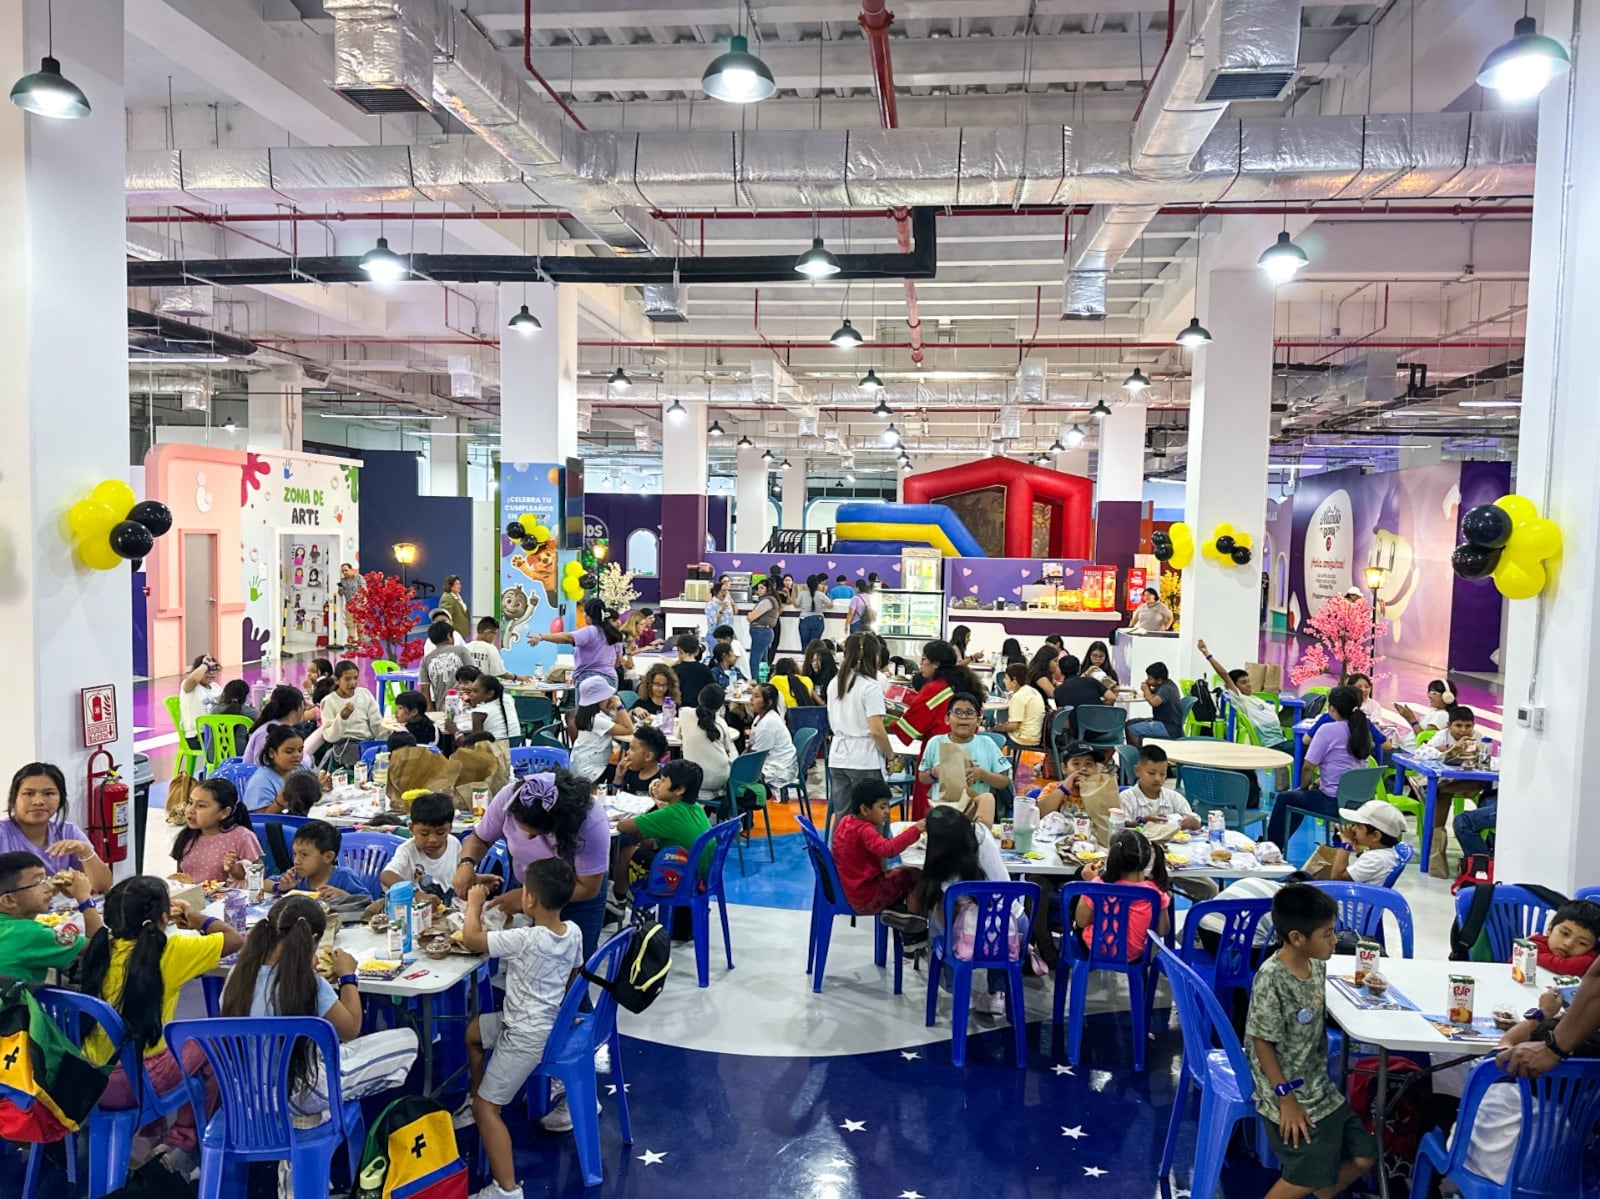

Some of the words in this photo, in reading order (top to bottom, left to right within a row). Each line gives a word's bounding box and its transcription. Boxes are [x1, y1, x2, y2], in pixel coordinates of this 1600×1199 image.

[284, 486, 310, 504] ZONA
[313, 490, 324, 506] DE
[292, 507, 319, 526] ARTE
[505, 504, 553, 512] CUMPLEAÑOS
